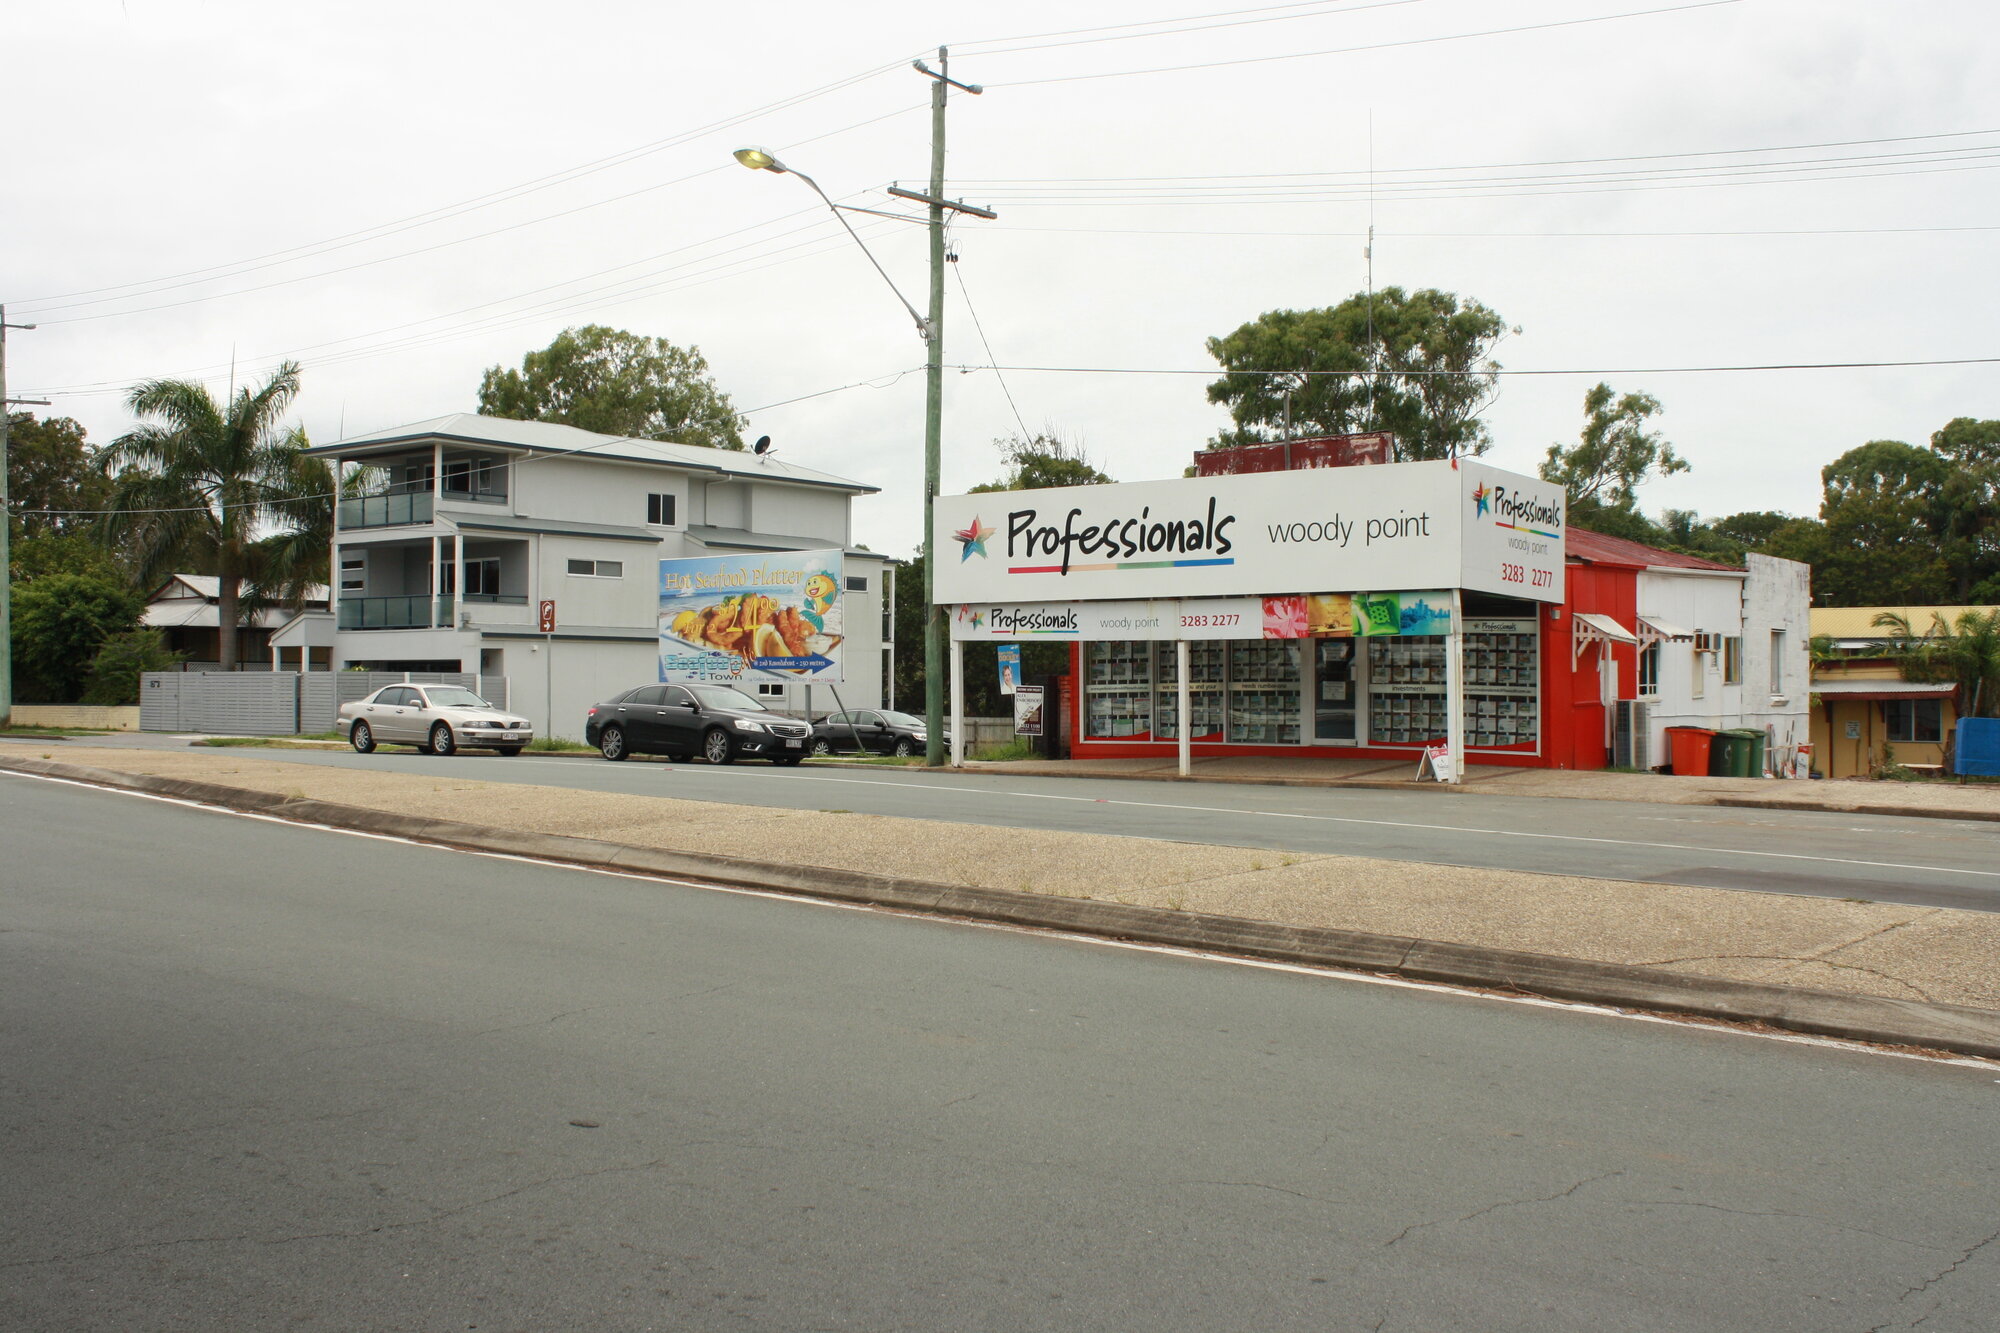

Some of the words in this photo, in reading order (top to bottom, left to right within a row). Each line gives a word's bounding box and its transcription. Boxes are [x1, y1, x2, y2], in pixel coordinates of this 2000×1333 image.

[1495, 486, 1560, 529] Professionals
[1008, 497, 1236, 576] Professionals
[1268, 512, 1353, 548] woody
[1366, 509, 1430, 546] point
[1508, 537, 1530, 555] woody
[1532, 541, 1548, 556] point
[665, 573, 692, 590] Hot
[695, 562, 748, 592] Seafood
[752, 561, 804, 585] Platter
[1502, 563, 1524, 583] 3283
[1532, 568, 1553, 588] 2277
[991, 608, 1078, 635] Professionals
[1100, 615, 1133, 630] woody
[1135, 616, 1159, 630] point
[1181, 615, 1208, 627] 3283
[1212, 614, 1240, 626] 2277
[709, 672, 743, 680] Town
